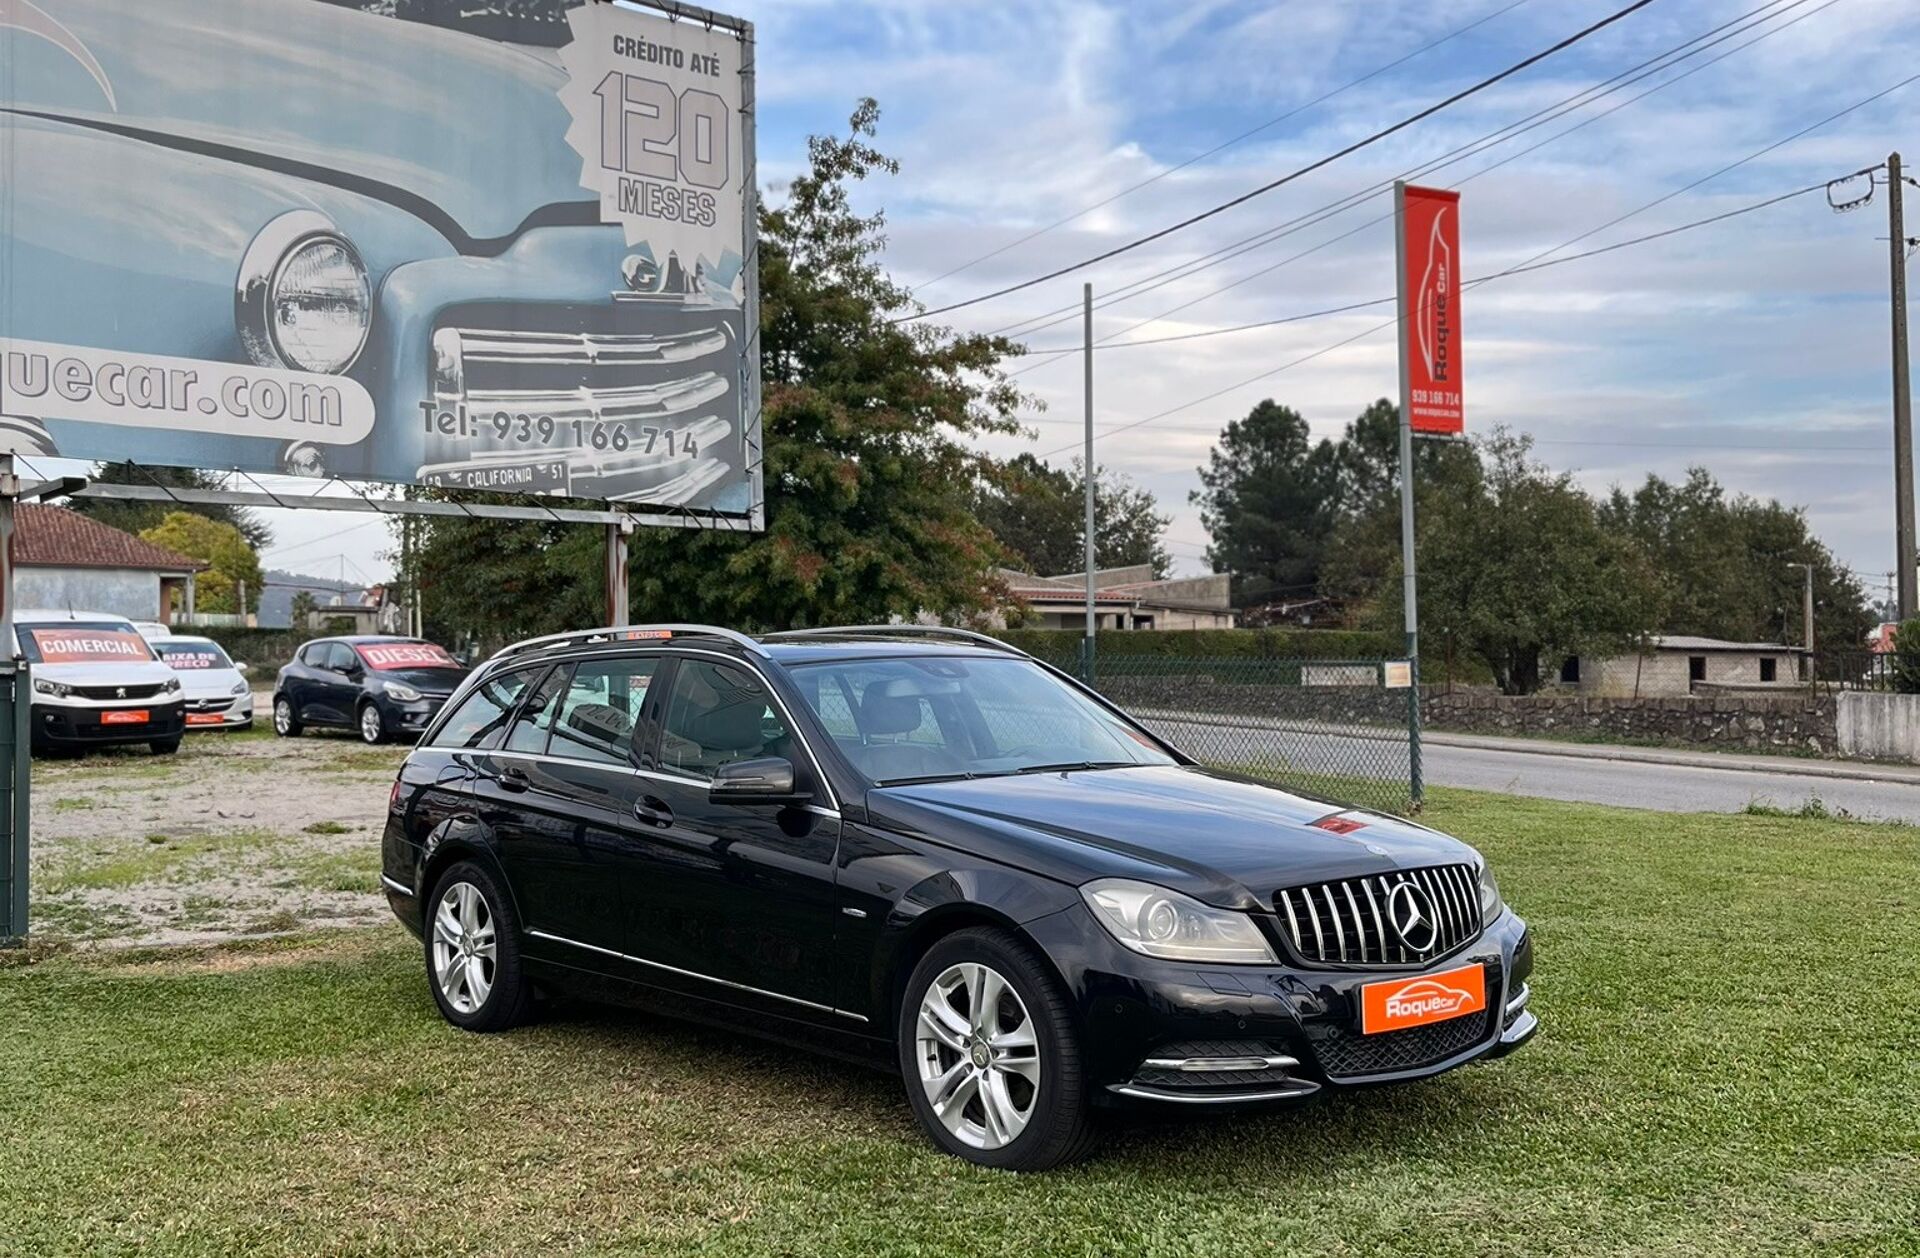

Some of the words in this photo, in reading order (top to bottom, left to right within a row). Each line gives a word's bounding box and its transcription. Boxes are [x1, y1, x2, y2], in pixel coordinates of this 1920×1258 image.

[613, 35, 684, 68] CRÉDITO
[690, 53, 720, 77] ATÉ
[592, 70, 729, 190] 120
[618, 177, 716, 228] MESES
[0, 352, 342, 426] uecar.com
[419, 402, 478, 437] Tel:
[492, 412, 555, 443] 939
[571, 420, 629, 451] 166
[642, 428, 699, 459] 714
[467, 467, 532, 488] CALIFORNIA
[551, 464, 563, 479] 51
[41, 639, 143, 656] COMERCIAL
[163, 653, 196, 661] AIXA
[198, 653, 217, 661] DE
[368, 648, 449, 665] DIESEL
